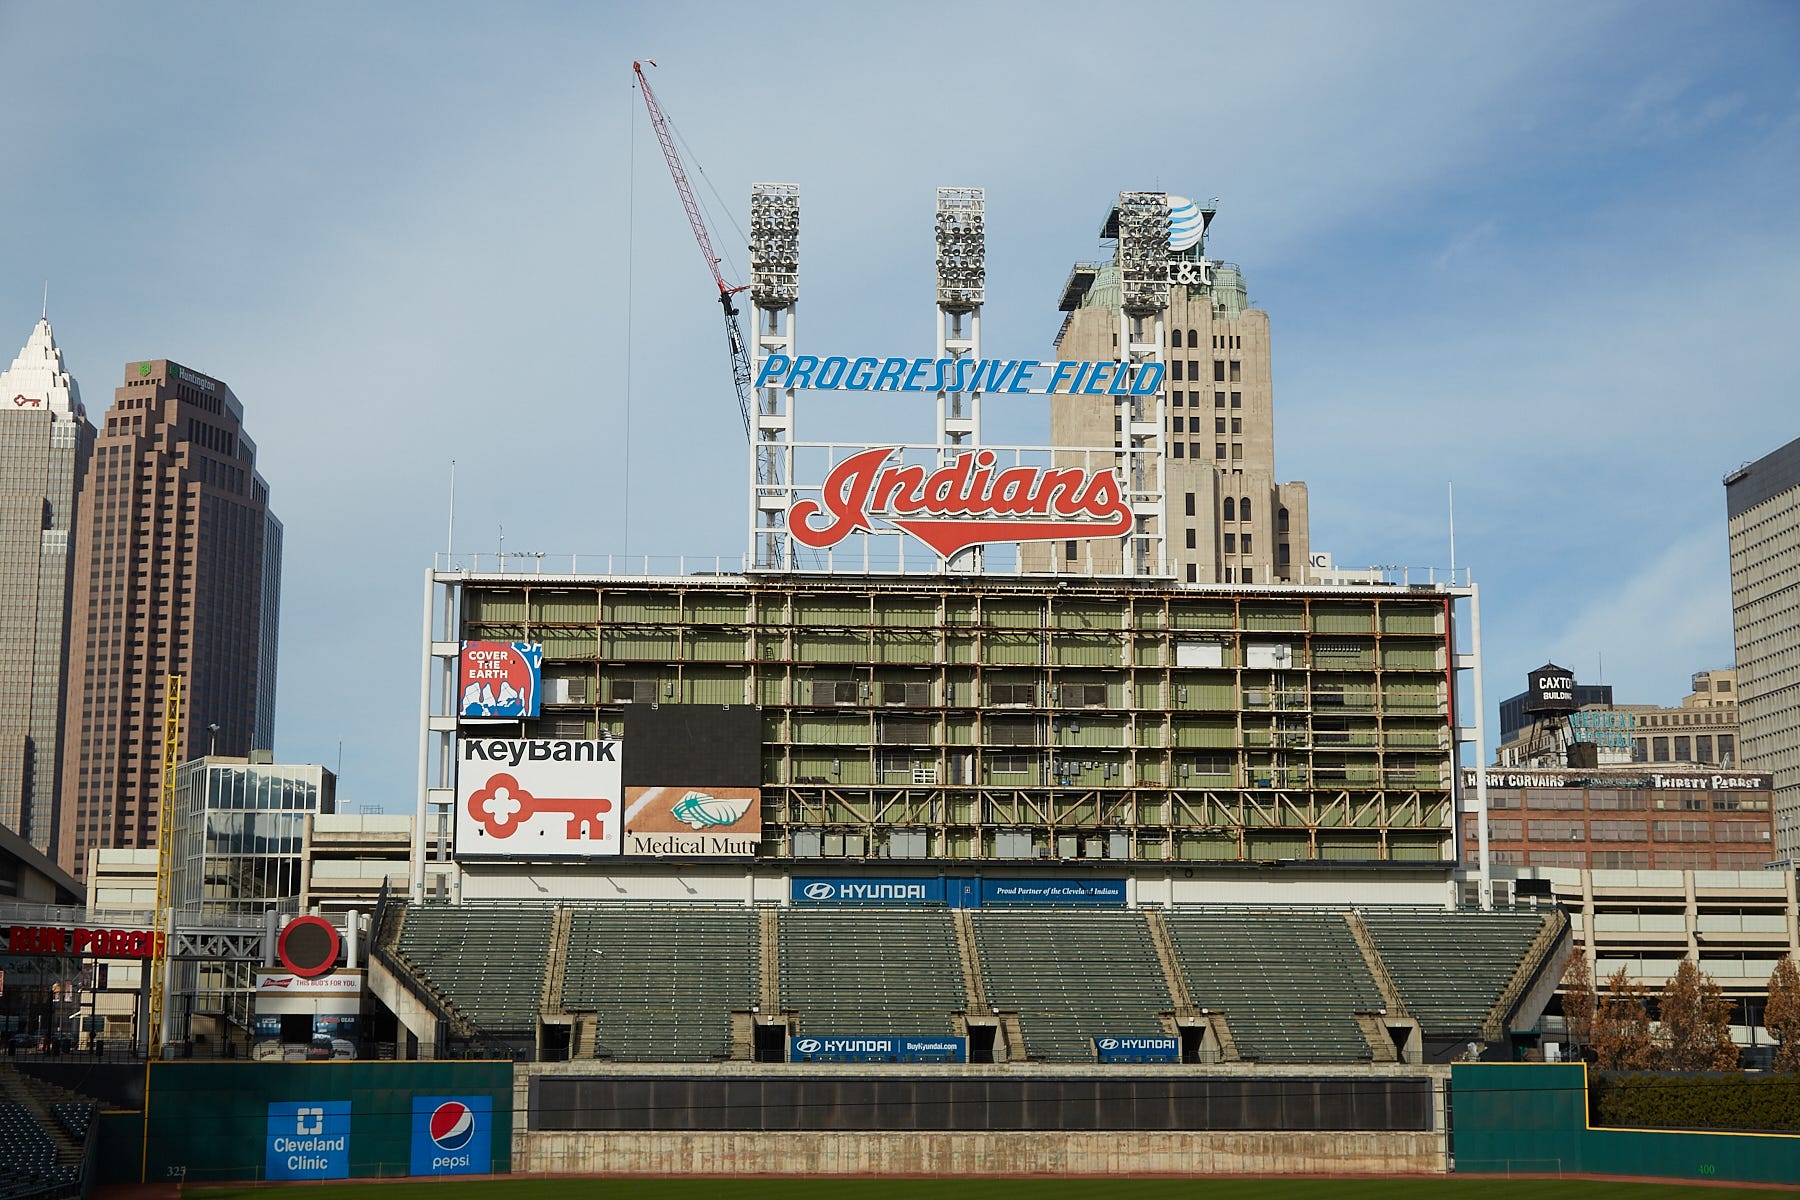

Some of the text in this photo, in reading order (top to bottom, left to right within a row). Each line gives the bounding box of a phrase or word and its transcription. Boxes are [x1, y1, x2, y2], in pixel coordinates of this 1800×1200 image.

[1167, 255, 1212, 286] t&t
[179, 367, 215, 392] Huntington
[755, 354, 1166, 396] PROGRESSIVE FIELD
[786, 446, 1134, 563] Indians
[1309, 555, 1327, 568] NC
[468, 650, 508, 661] COVER
[477, 660, 501, 669] THE
[469, 669, 508, 679] EARTH
[465, 740, 616, 767] KeyBank
[1467, 774, 1504, 788] HRRY
[1508, 774, 1565, 788] CORVAIRS
[634, 836, 704, 854] Medical
[840, 884, 926, 899] HYUNDAI
[997, 887, 1119, 897] Proud Partner of the Cleveland Indians
[8, 926, 66, 953] RUN
[824, 1040, 958, 1052] HYUNDAI BuyHyundai.com
[1121, 1040, 1175, 1049] HYUNDAI
[274, 1136, 345, 1153] Cleveland
[287, 1155, 328, 1170] Clinic
[432, 1154, 470, 1170] pepsi
